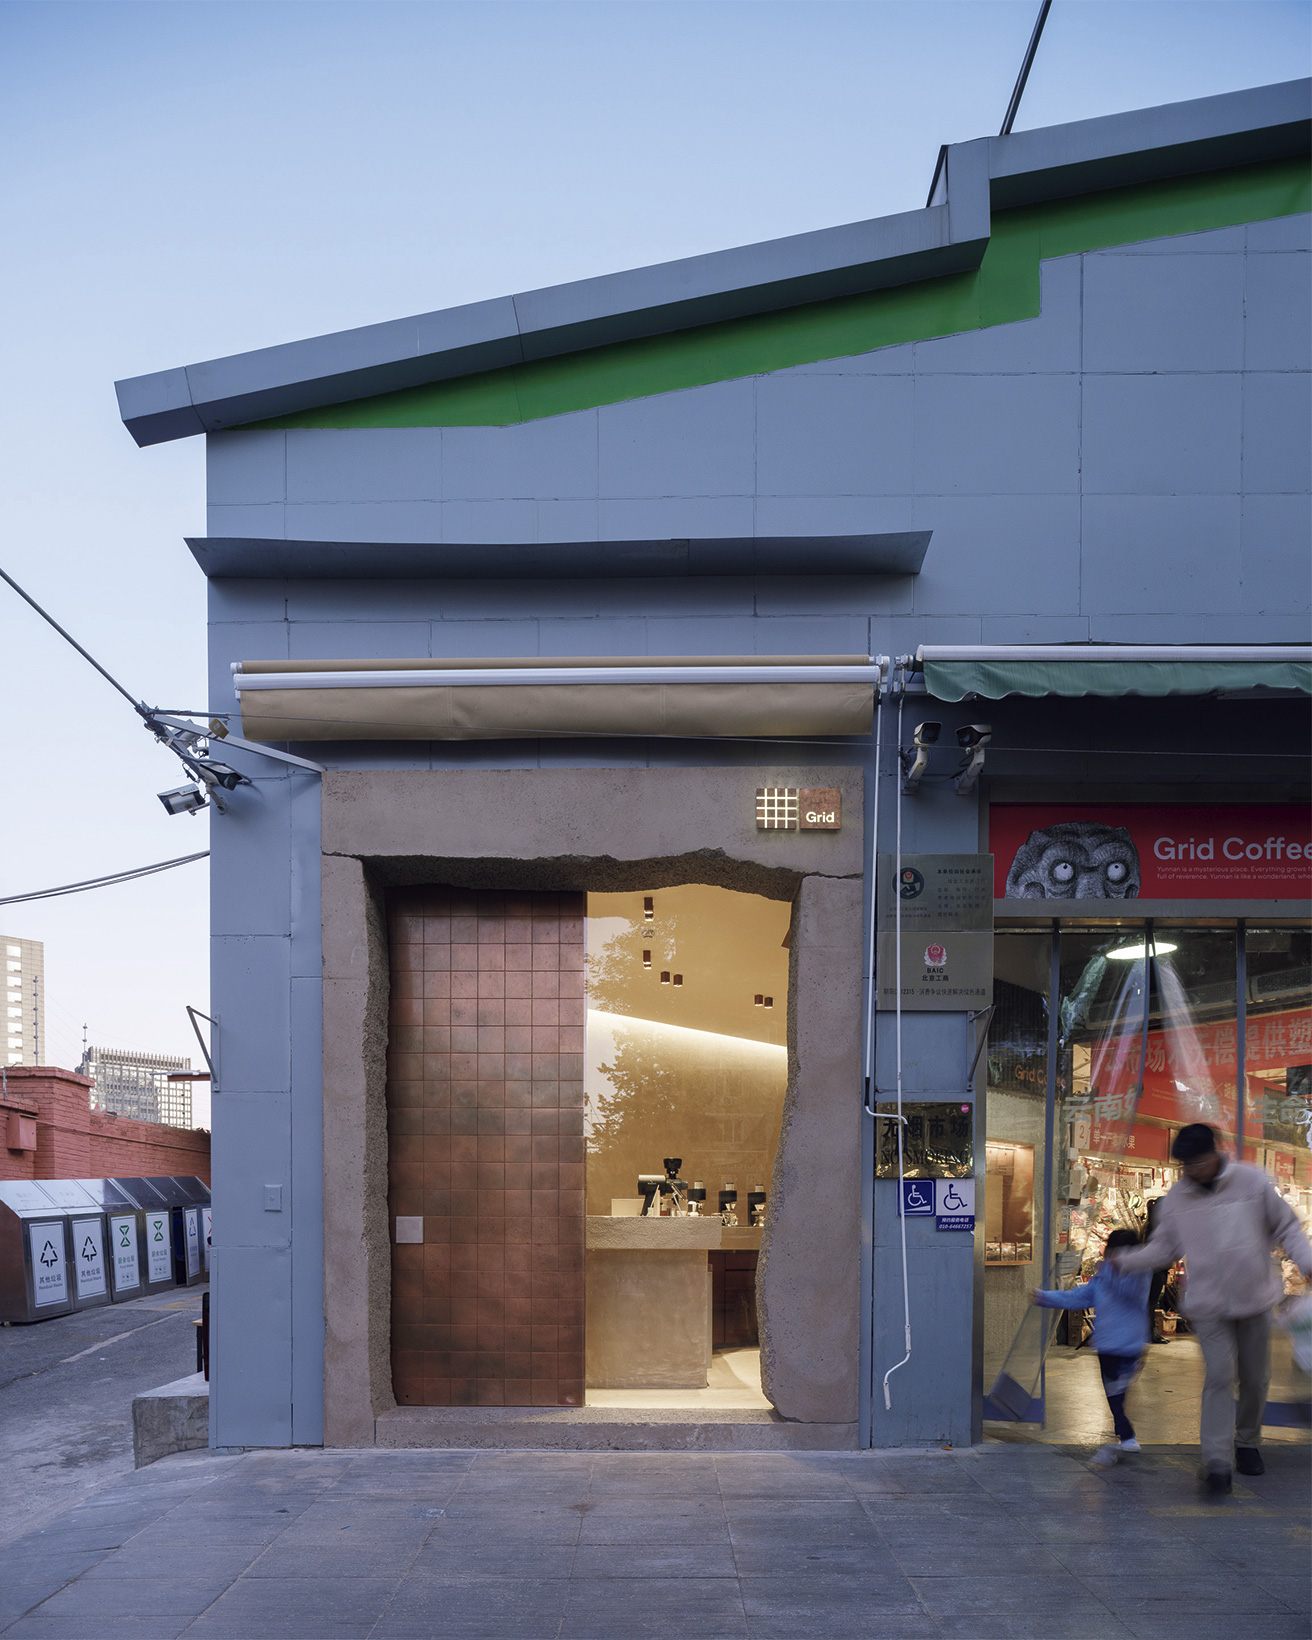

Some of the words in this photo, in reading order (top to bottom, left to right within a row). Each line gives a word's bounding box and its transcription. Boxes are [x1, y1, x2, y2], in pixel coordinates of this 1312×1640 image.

[805, 811, 835, 823] Grid
[1153, 837, 1214, 860] Grid
[1194, 866, 1229, 874] mysterious
[1250, 866, 1286, 874] Everything
[1015, 1064, 1036, 1082] Grid
[1079, 1125, 1085, 1139] 2
[39, 1273, 62, 1284] 其他垃圾
[81, 1267, 101, 1278] 其他垃圾
